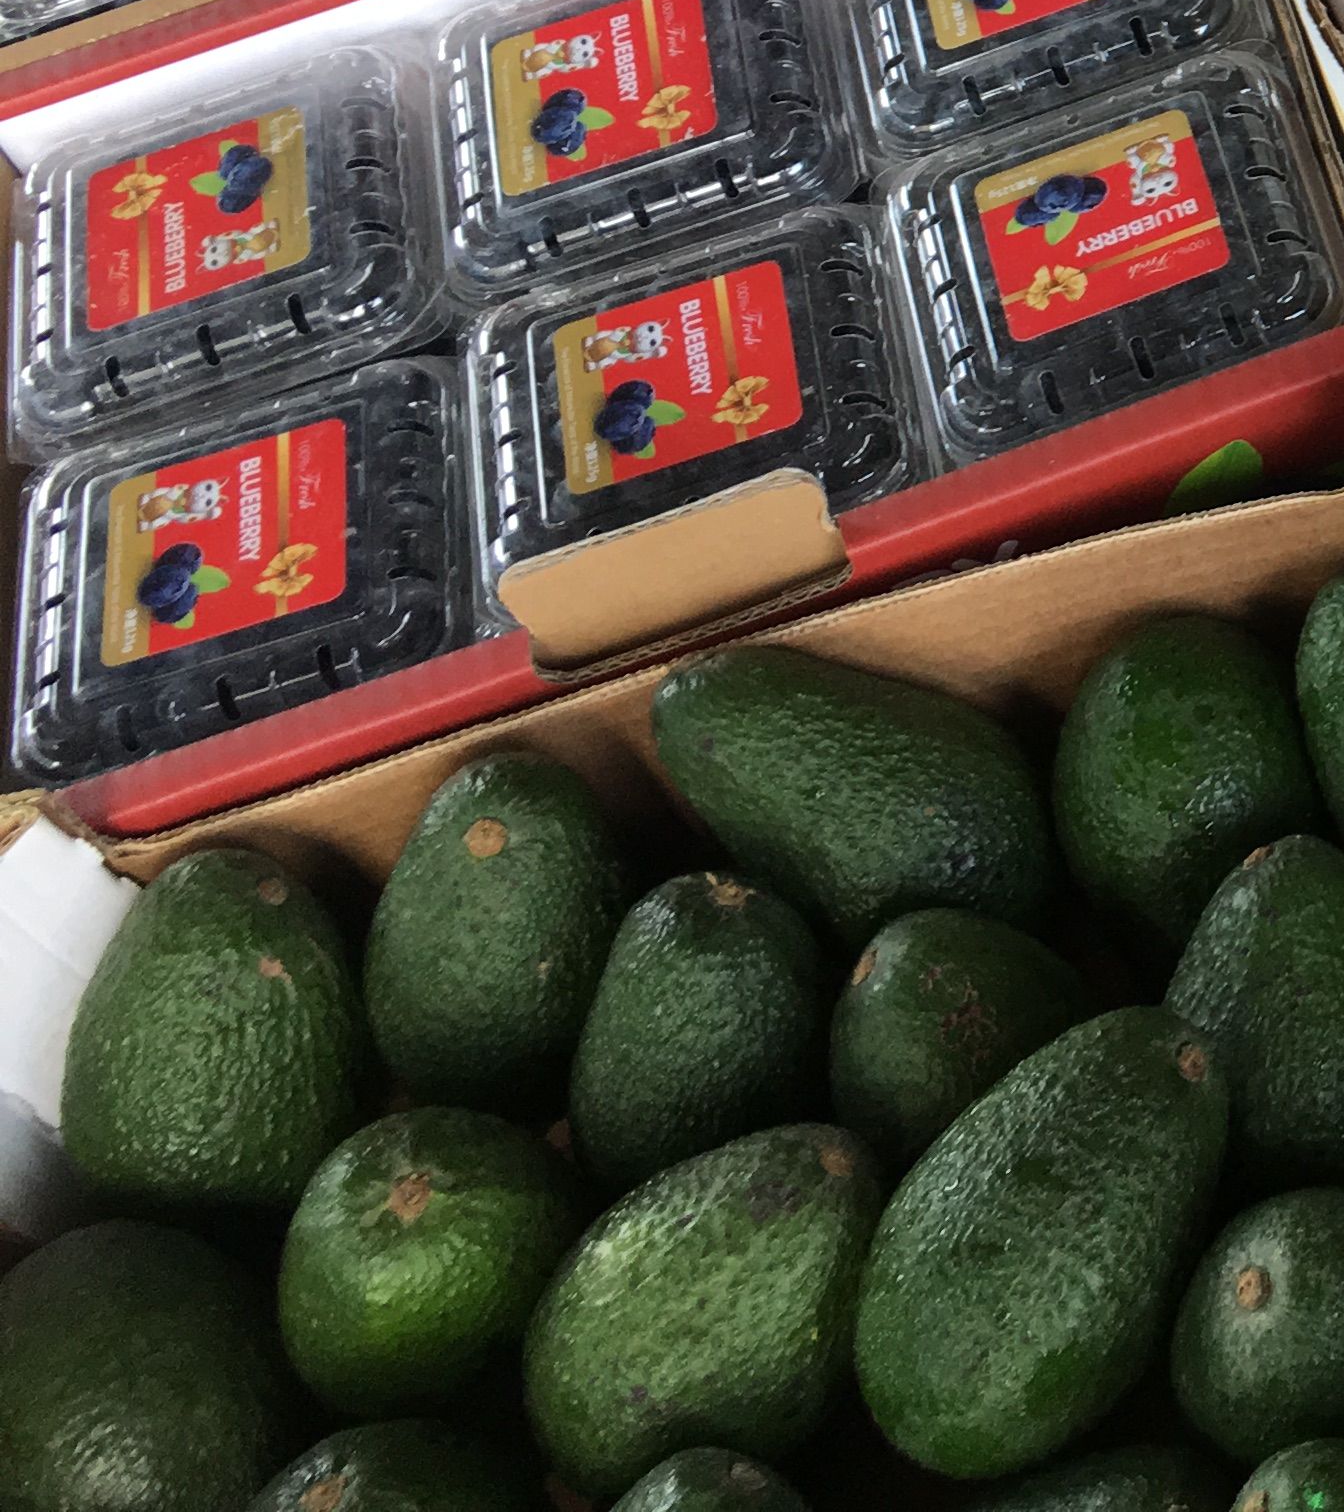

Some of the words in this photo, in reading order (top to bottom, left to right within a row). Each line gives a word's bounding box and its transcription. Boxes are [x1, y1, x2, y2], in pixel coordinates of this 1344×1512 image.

[610, 14, 639, 102] BLUEBERRY
[163, 202, 186, 293] BLUEBERRY
[1076, 198, 1199, 257] BLUEBERRY
[679, 298, 712, 395] BLUEBERRY
[239, 456, 261, 561] BLUEBERRY
